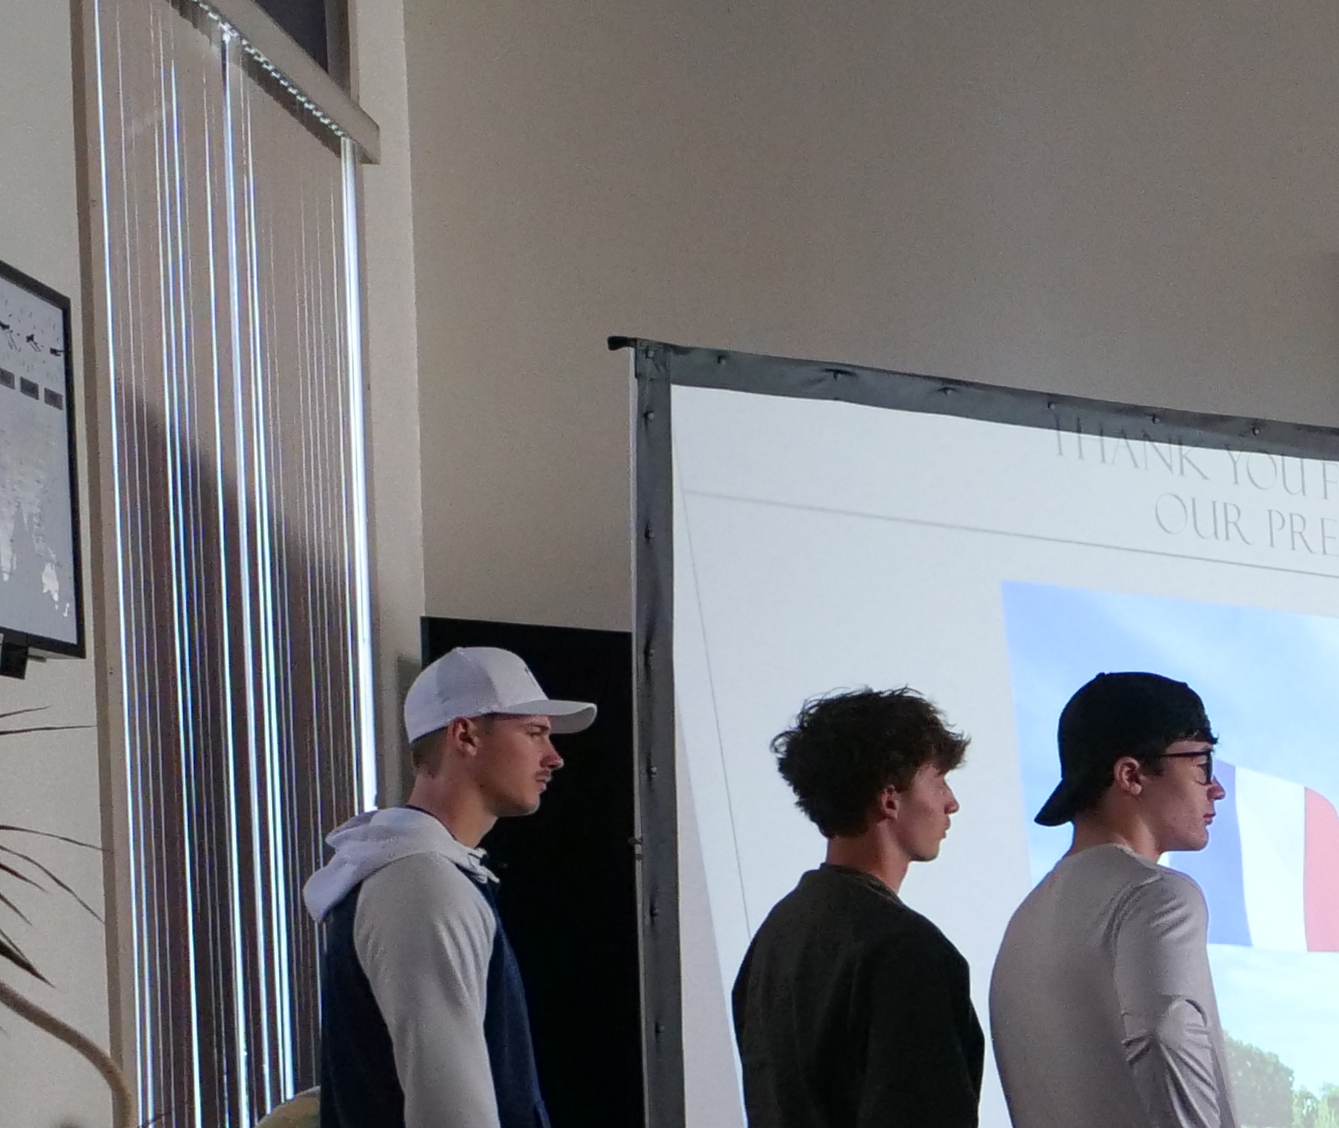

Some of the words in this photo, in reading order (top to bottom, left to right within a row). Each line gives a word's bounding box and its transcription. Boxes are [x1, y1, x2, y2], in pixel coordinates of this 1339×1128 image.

[1050, 411, 1210, 481] THANK
[1224, 443, 1308, 497] YOU
[1154, 492, 1252, 546] OUR
